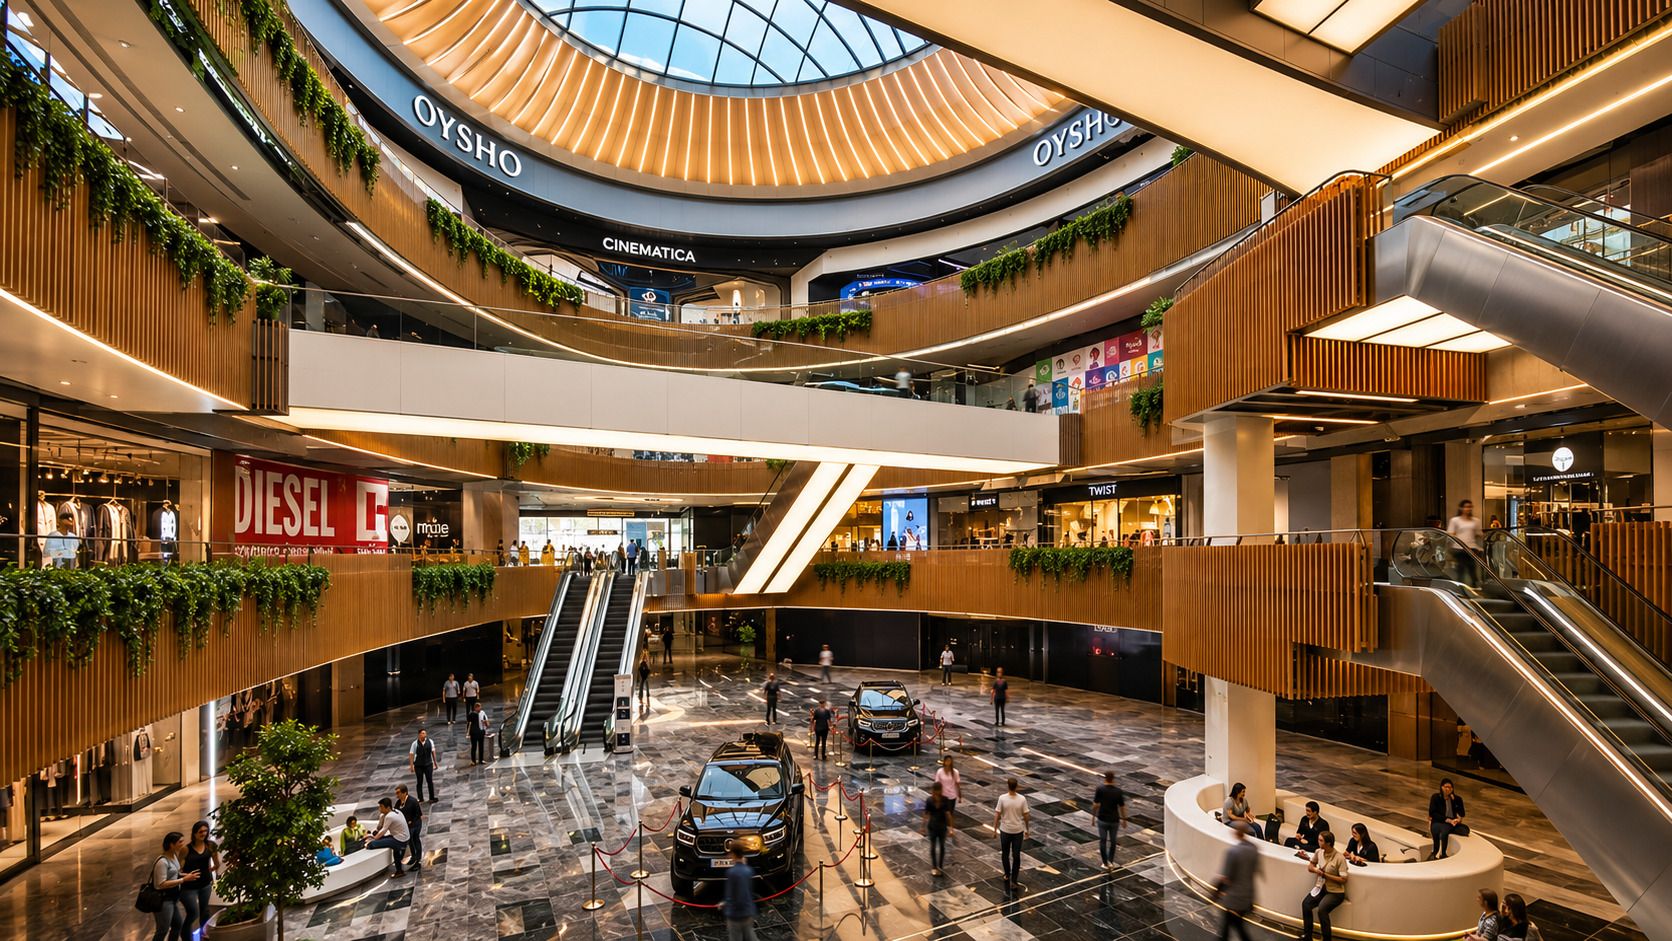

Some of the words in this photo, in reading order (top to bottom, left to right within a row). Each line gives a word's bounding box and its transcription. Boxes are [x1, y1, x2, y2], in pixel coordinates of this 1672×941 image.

[413, 95, 522, 177] OYSHO
[602, 237, 696, 263] CINEMATICA
[234, 464, 335, 538] DIESEL
[1088, 484, 1117, 496] TWIST
